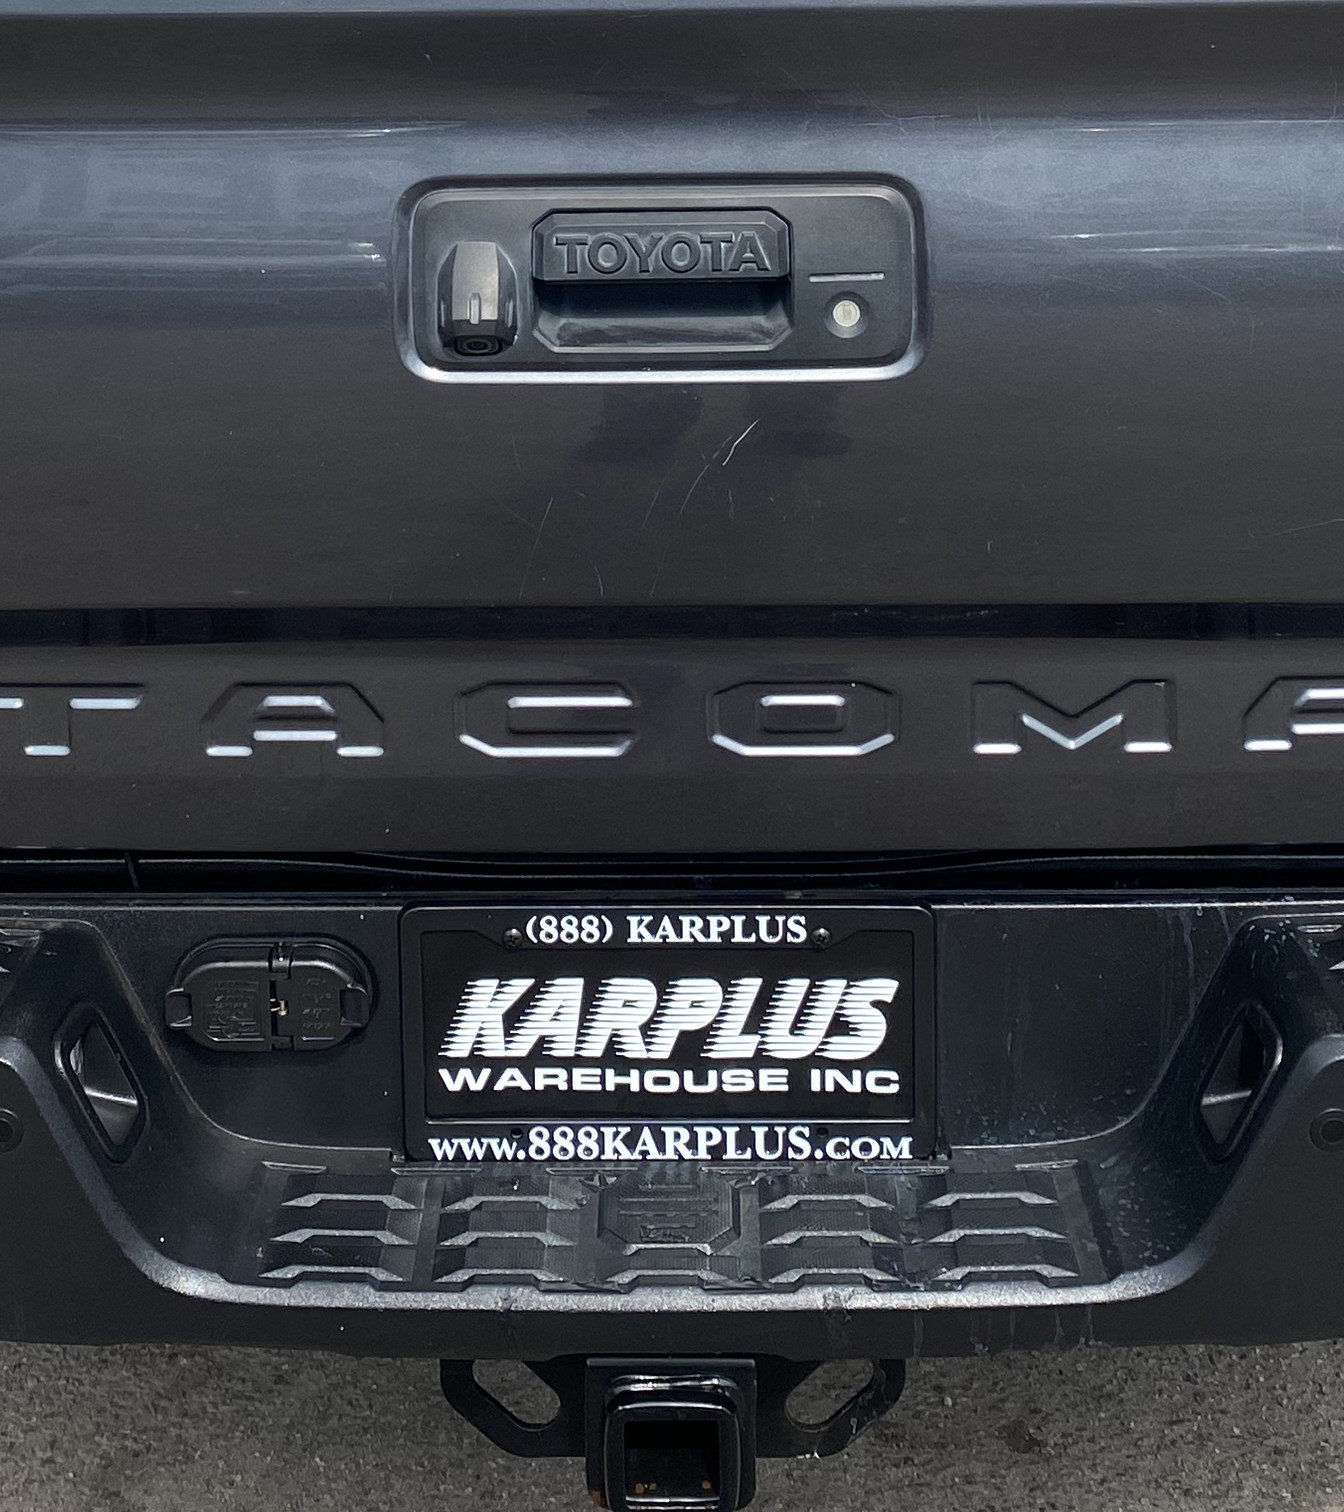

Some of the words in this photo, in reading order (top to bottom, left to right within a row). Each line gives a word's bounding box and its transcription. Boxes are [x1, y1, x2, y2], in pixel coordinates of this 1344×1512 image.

[555, 232, 771, 274] TOYOTA
[525, 915, 613, 945] (888)
[627, 915, 807, 944] KARPLUS
[438, 977, 900, 1060] KARPLUS
[438, 1067, 790, 1094] WAREHOUSE
[809, 1067, 900, 1094] INC
